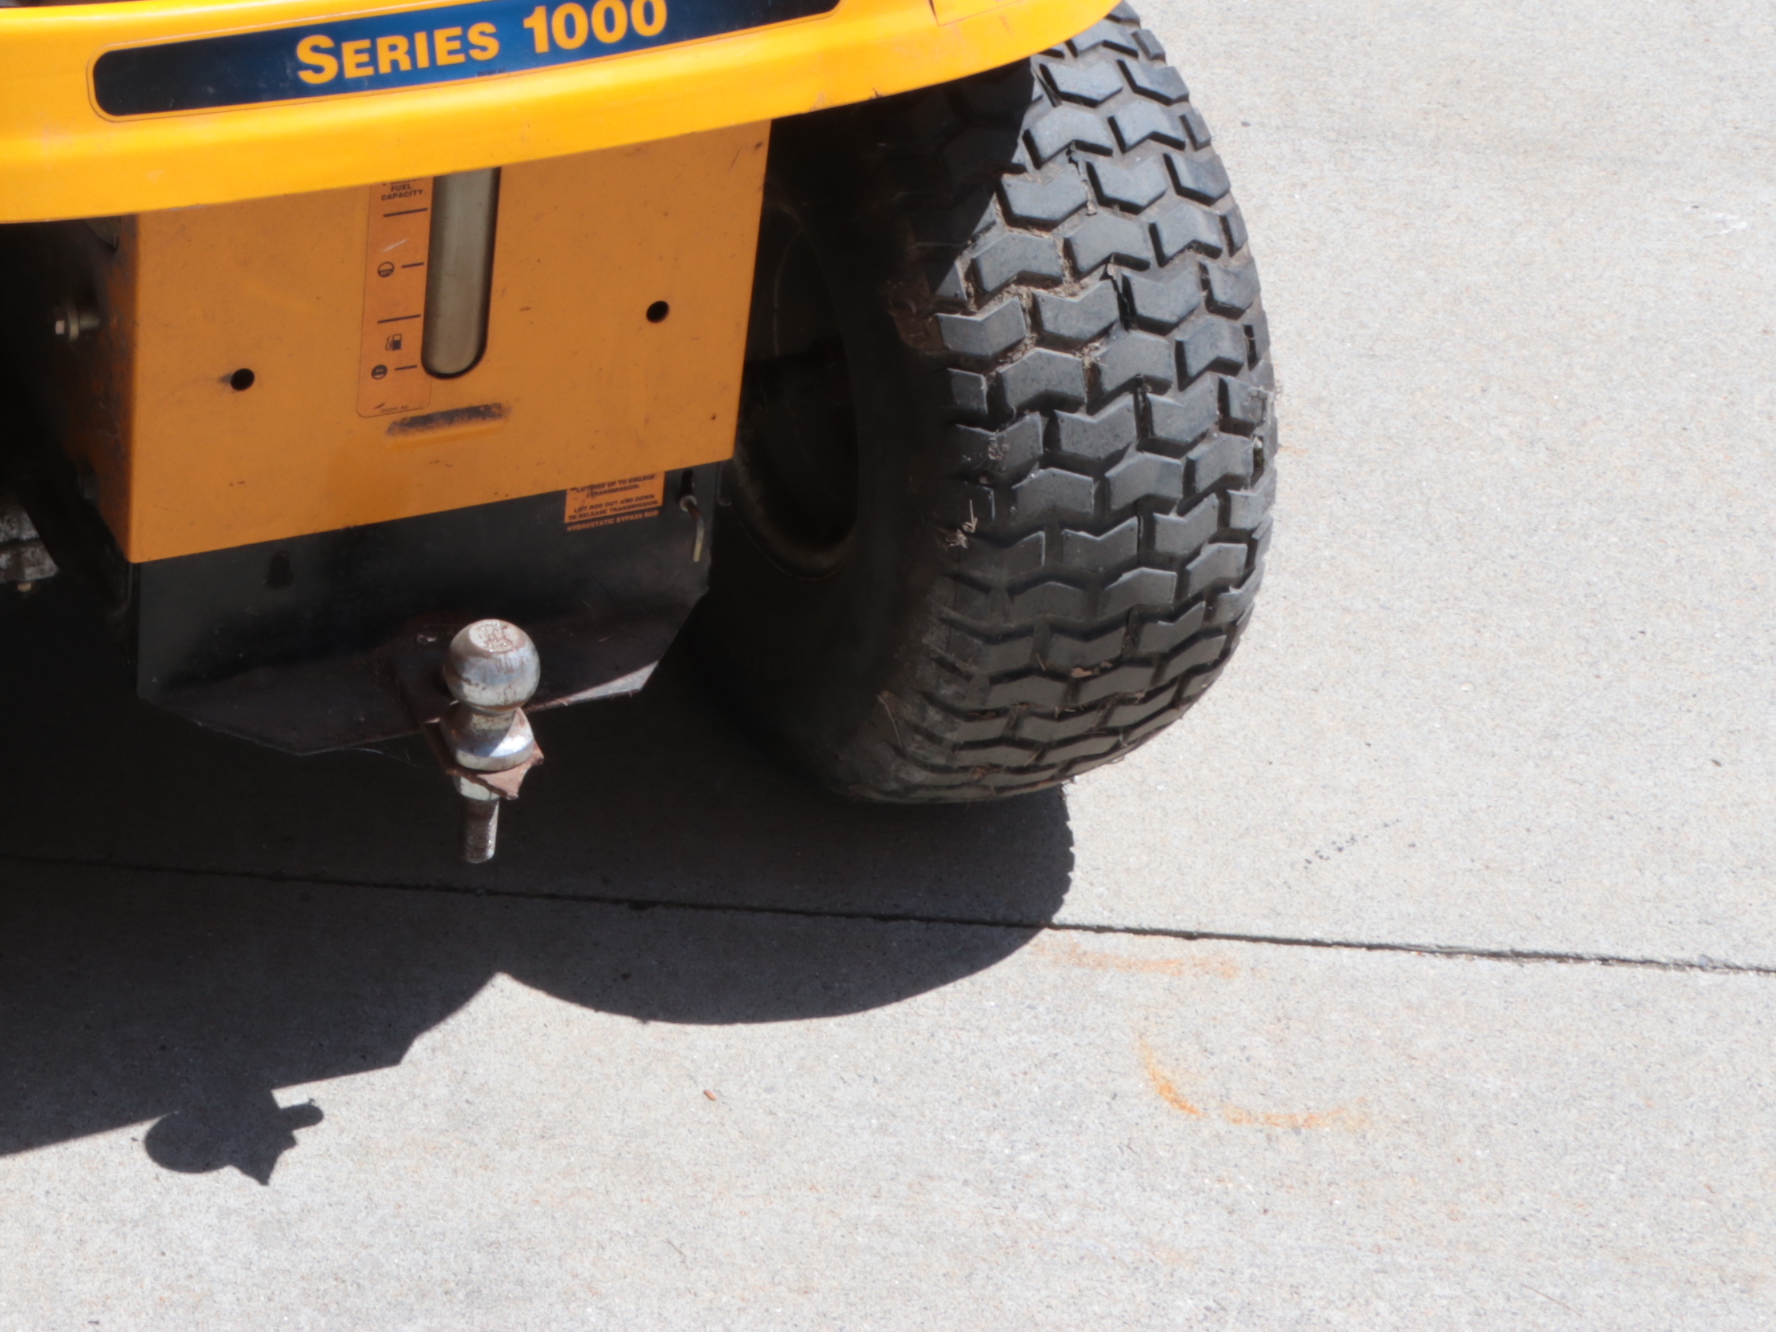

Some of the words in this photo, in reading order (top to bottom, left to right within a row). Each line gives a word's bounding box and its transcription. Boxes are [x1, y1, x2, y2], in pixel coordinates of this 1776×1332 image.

[390, 183, 413, 192] FUEL
[380, 188, 424, 201] CAPACITY
[579, 509, 607, 519] RELEASE
[567, 518, 615, 532] HYDROSTATIC
[616, 512, 644, 523] BYPASS
[644, 510, 660, 519] ROD
